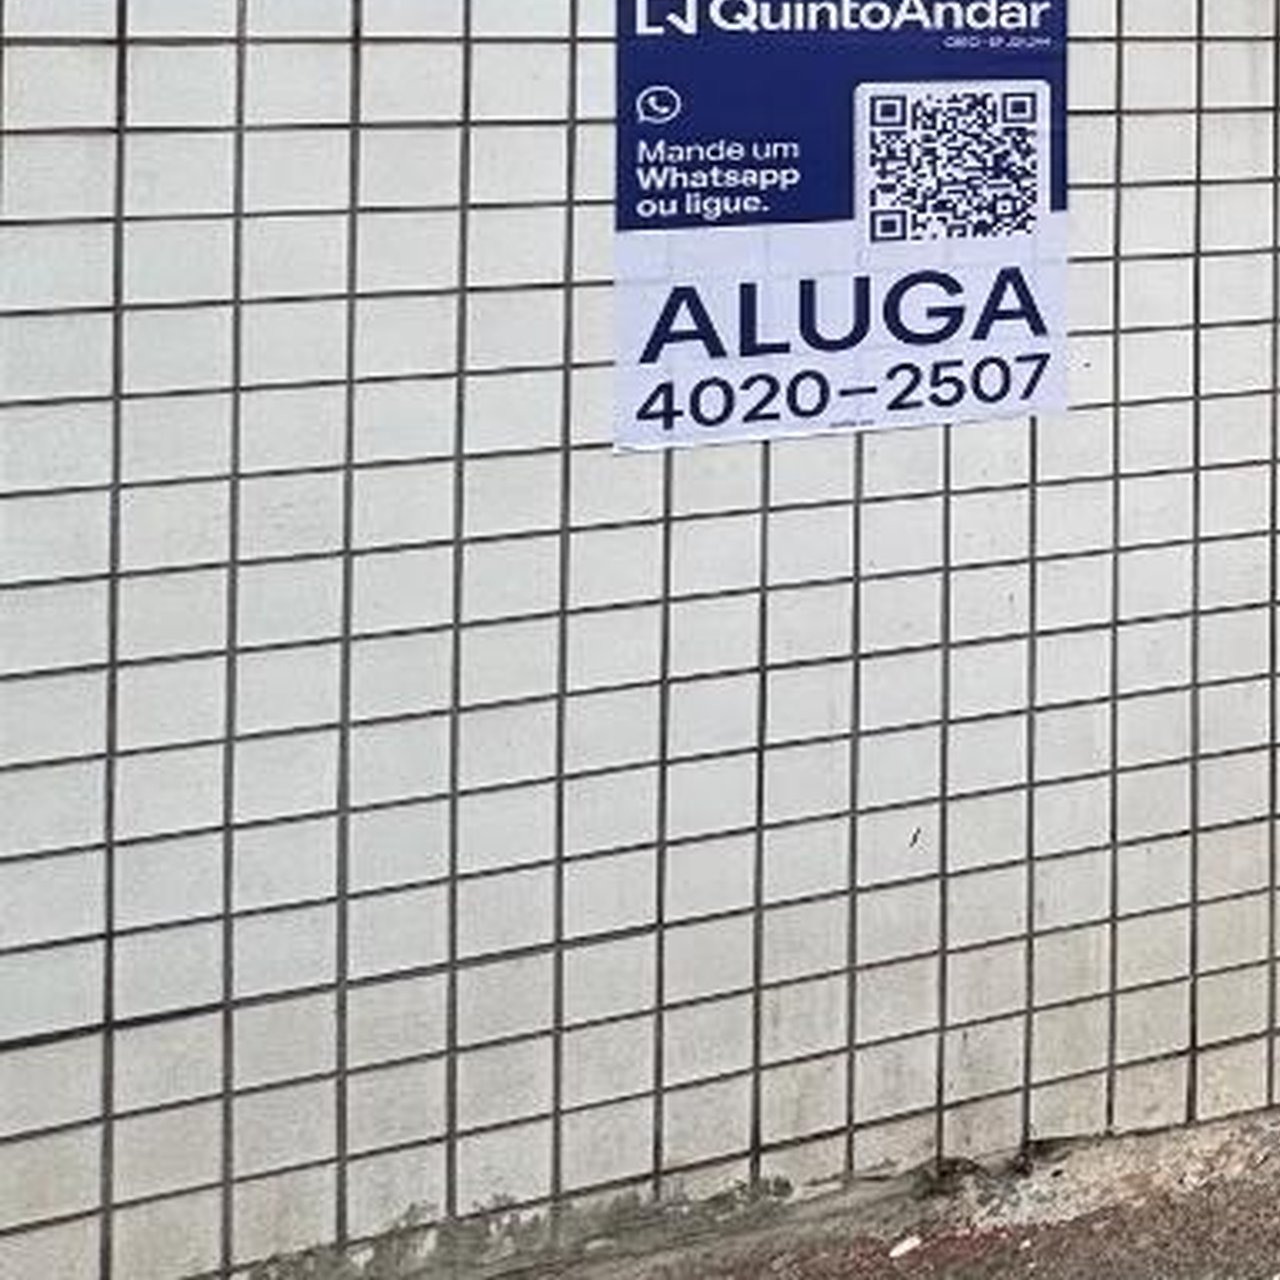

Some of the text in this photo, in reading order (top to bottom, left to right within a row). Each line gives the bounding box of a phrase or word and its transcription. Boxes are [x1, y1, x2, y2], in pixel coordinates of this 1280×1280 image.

[636, 138, 800, 163] Mande um
[636, 164, 800, 192] Whatsapp
[636, 191, 770, 219] ou ligue.
[639, 266, 1049, 364] ALUGA
[636, 352, 1051, 431] 4020-2507
